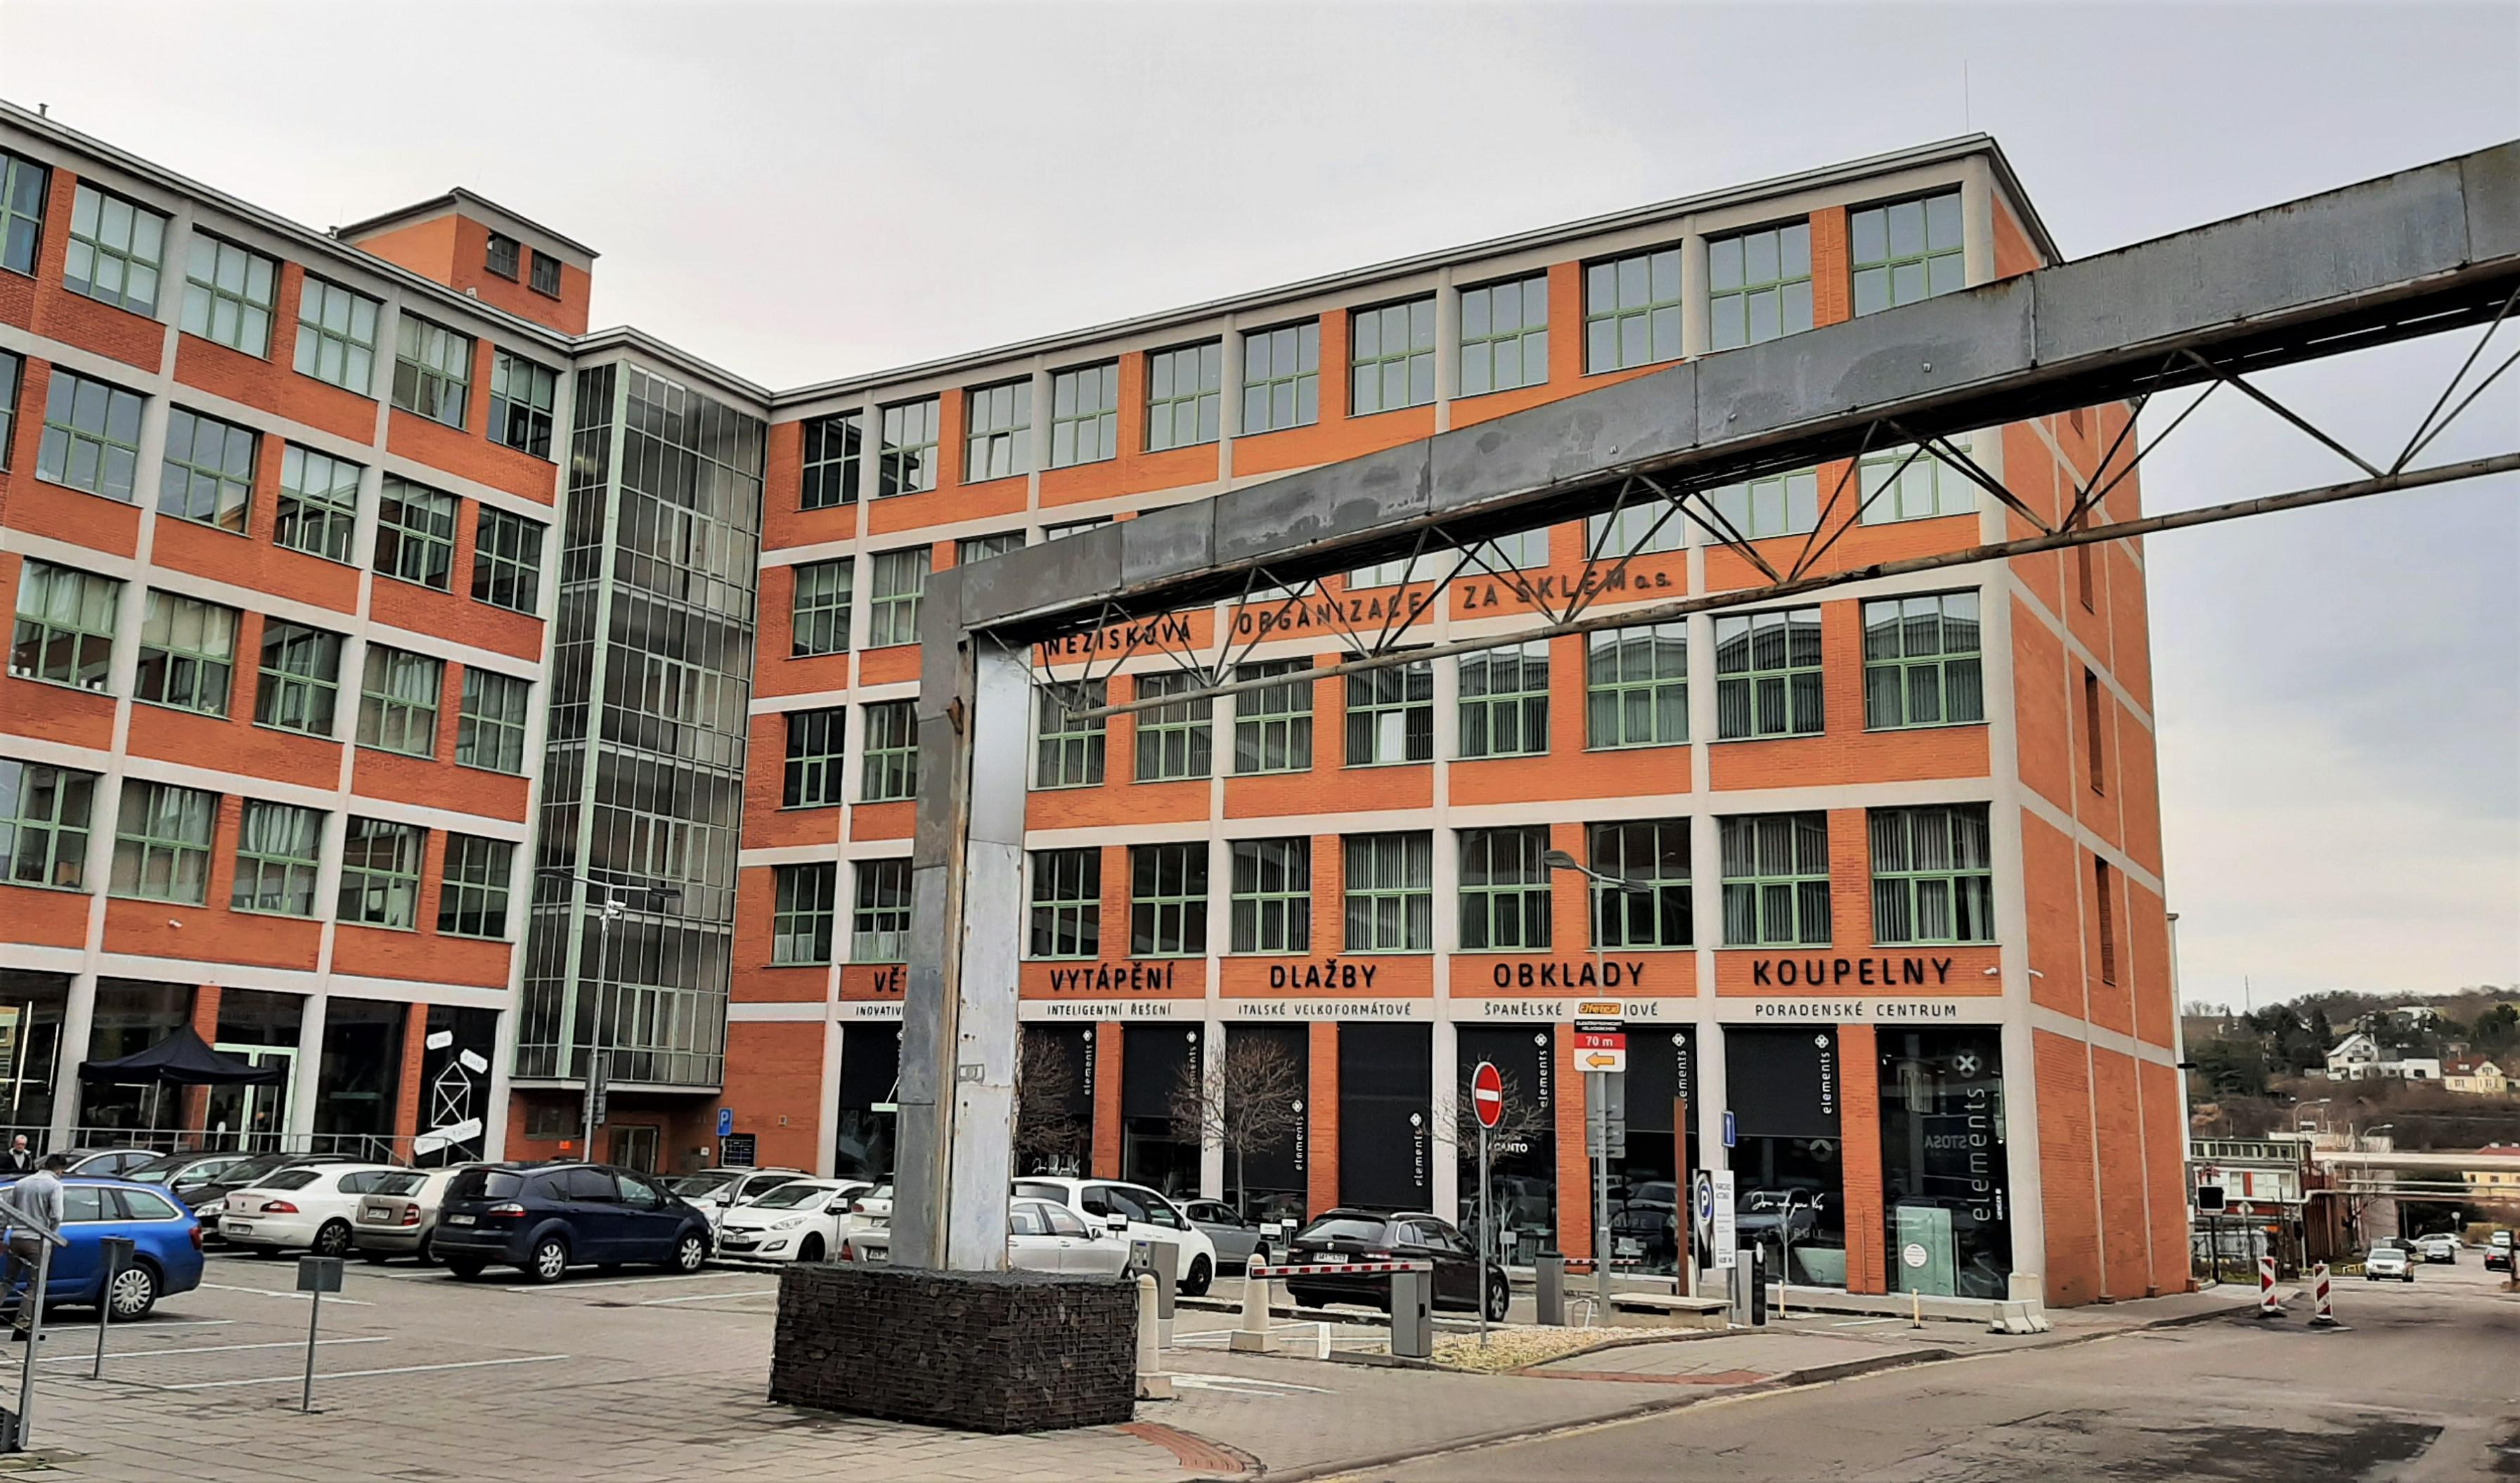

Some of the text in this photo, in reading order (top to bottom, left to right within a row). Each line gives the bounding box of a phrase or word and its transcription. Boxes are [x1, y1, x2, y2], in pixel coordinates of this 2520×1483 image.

[1047, 615, 1191, 656] NEZISKOVÁ
[1239, 592, 1422, 634] ORGANIZACE
[1463, 584, 1498, 609] ZA
[1516, 568, 1625, 602] SKLEM
[874, 966, 906, 992] VĚ
[1050, 961, 1174, 991] VYTÁPĚNÍ
[1270, 959, 1376, 988] DLAŽBY
[1494, 962, 1643, 987] OBKLADY
[1754, 957, 1951, 985] KOUPELNY
[856, 1006, 905, 1016] INOVATIV
[1047, 1003, 1171, 1016] INTELIGENTNÍ ŘEŠENÍ
[1239, 1002, 1411, 1016] ITALSKÉ VELKOFORMÁTOVÉ
[1485, 1002, 1562, 1016] ŠPANĚLSKÉ
[1755, 1001, 1956, 1016] PORADENSKÉ CENTRUM
[1586, 1036, 1613, 1047] 70 m
[1083, 1044, 1092, 1095] elements
[1538, 1050, 1548, 1108] elements
[1820, 1052, 1832, 1114] elements
[1294, 1116, 1304, 1170] elements
[1414, 1127, 1423, 1186] elements
[1964, 1089, 1991, 1221] elements
